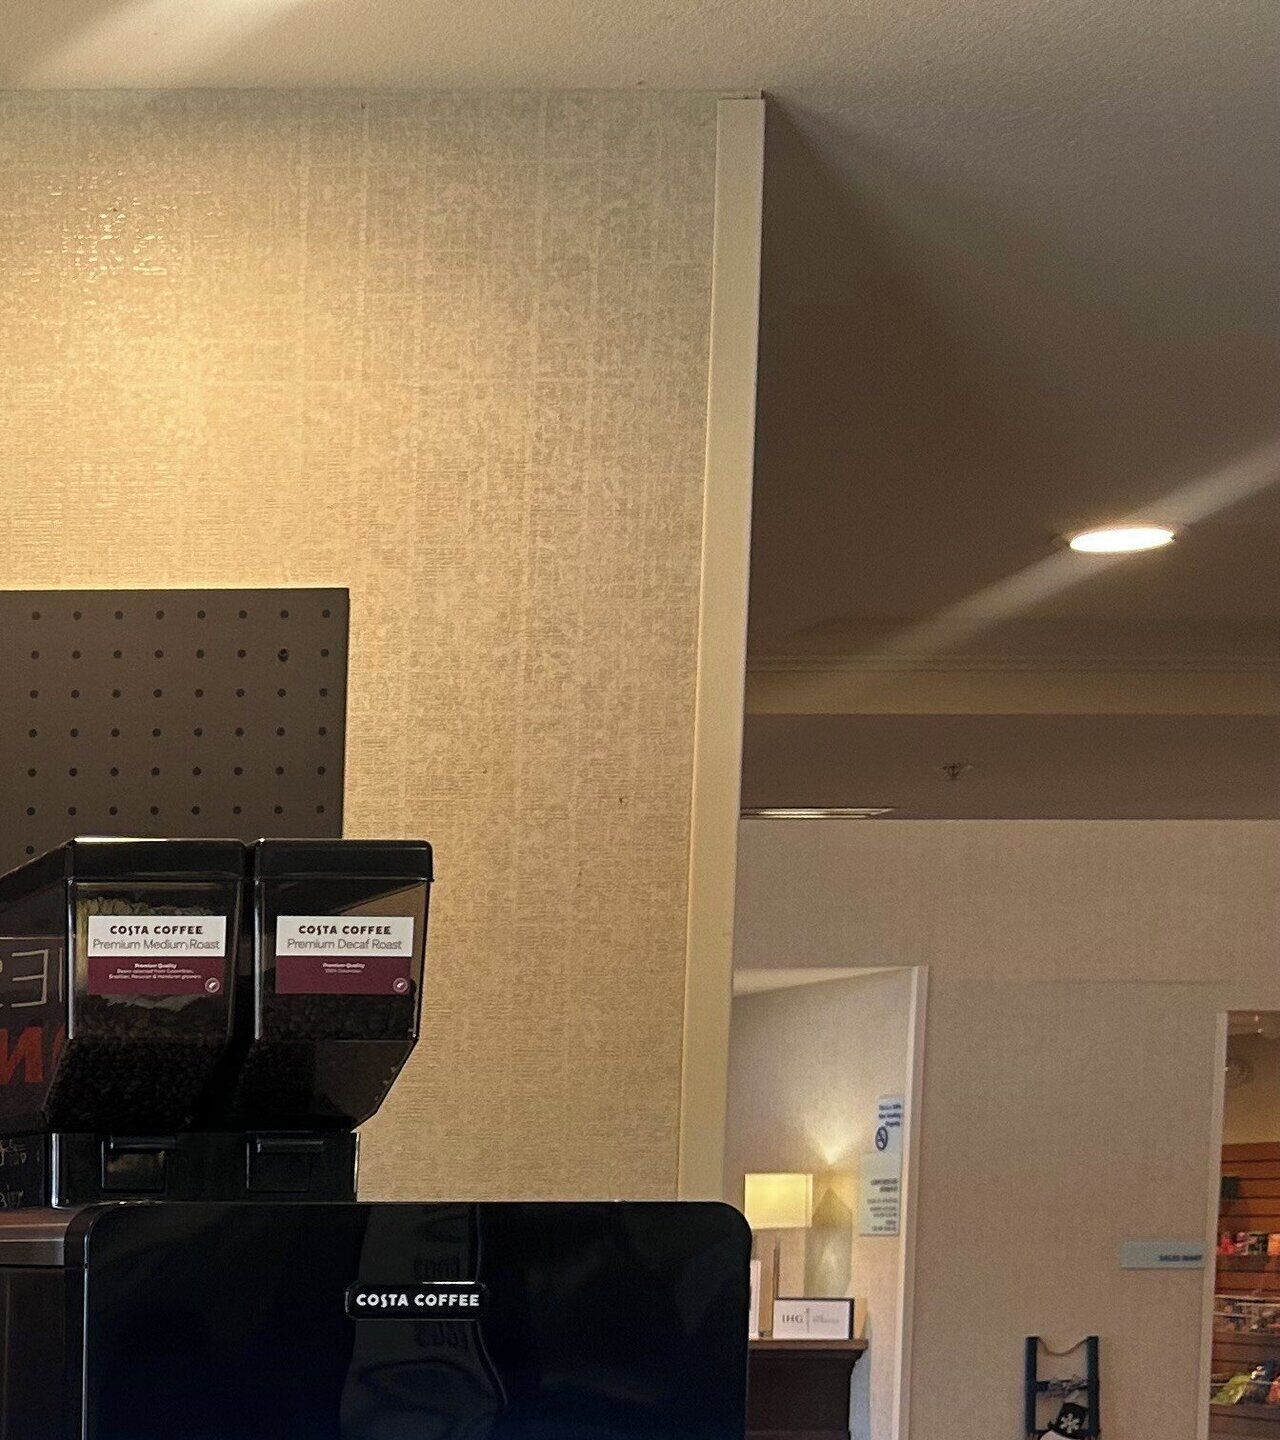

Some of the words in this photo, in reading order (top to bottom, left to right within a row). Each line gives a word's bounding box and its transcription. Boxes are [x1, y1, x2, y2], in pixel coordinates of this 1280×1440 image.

[110, 925, 149, 936] COSTA
[153, 925, 204, 935] COFFEE
[298, 925, 337, 936] COSTA
[342, 925, 392, 935] COFFEE
[92, 939, 140, 950] Premium
[143, 939, 188, 950] Medium
[190, 939, 220, 950] Roast
[287, 939, 335, 950] Premium
[337, 939, 370, 950] Decaf
[371, 939, 402, 950] Roast
[356, 1293, 409, 1308] COSTA
[414, 1293, 480, 1307] COFFEE
